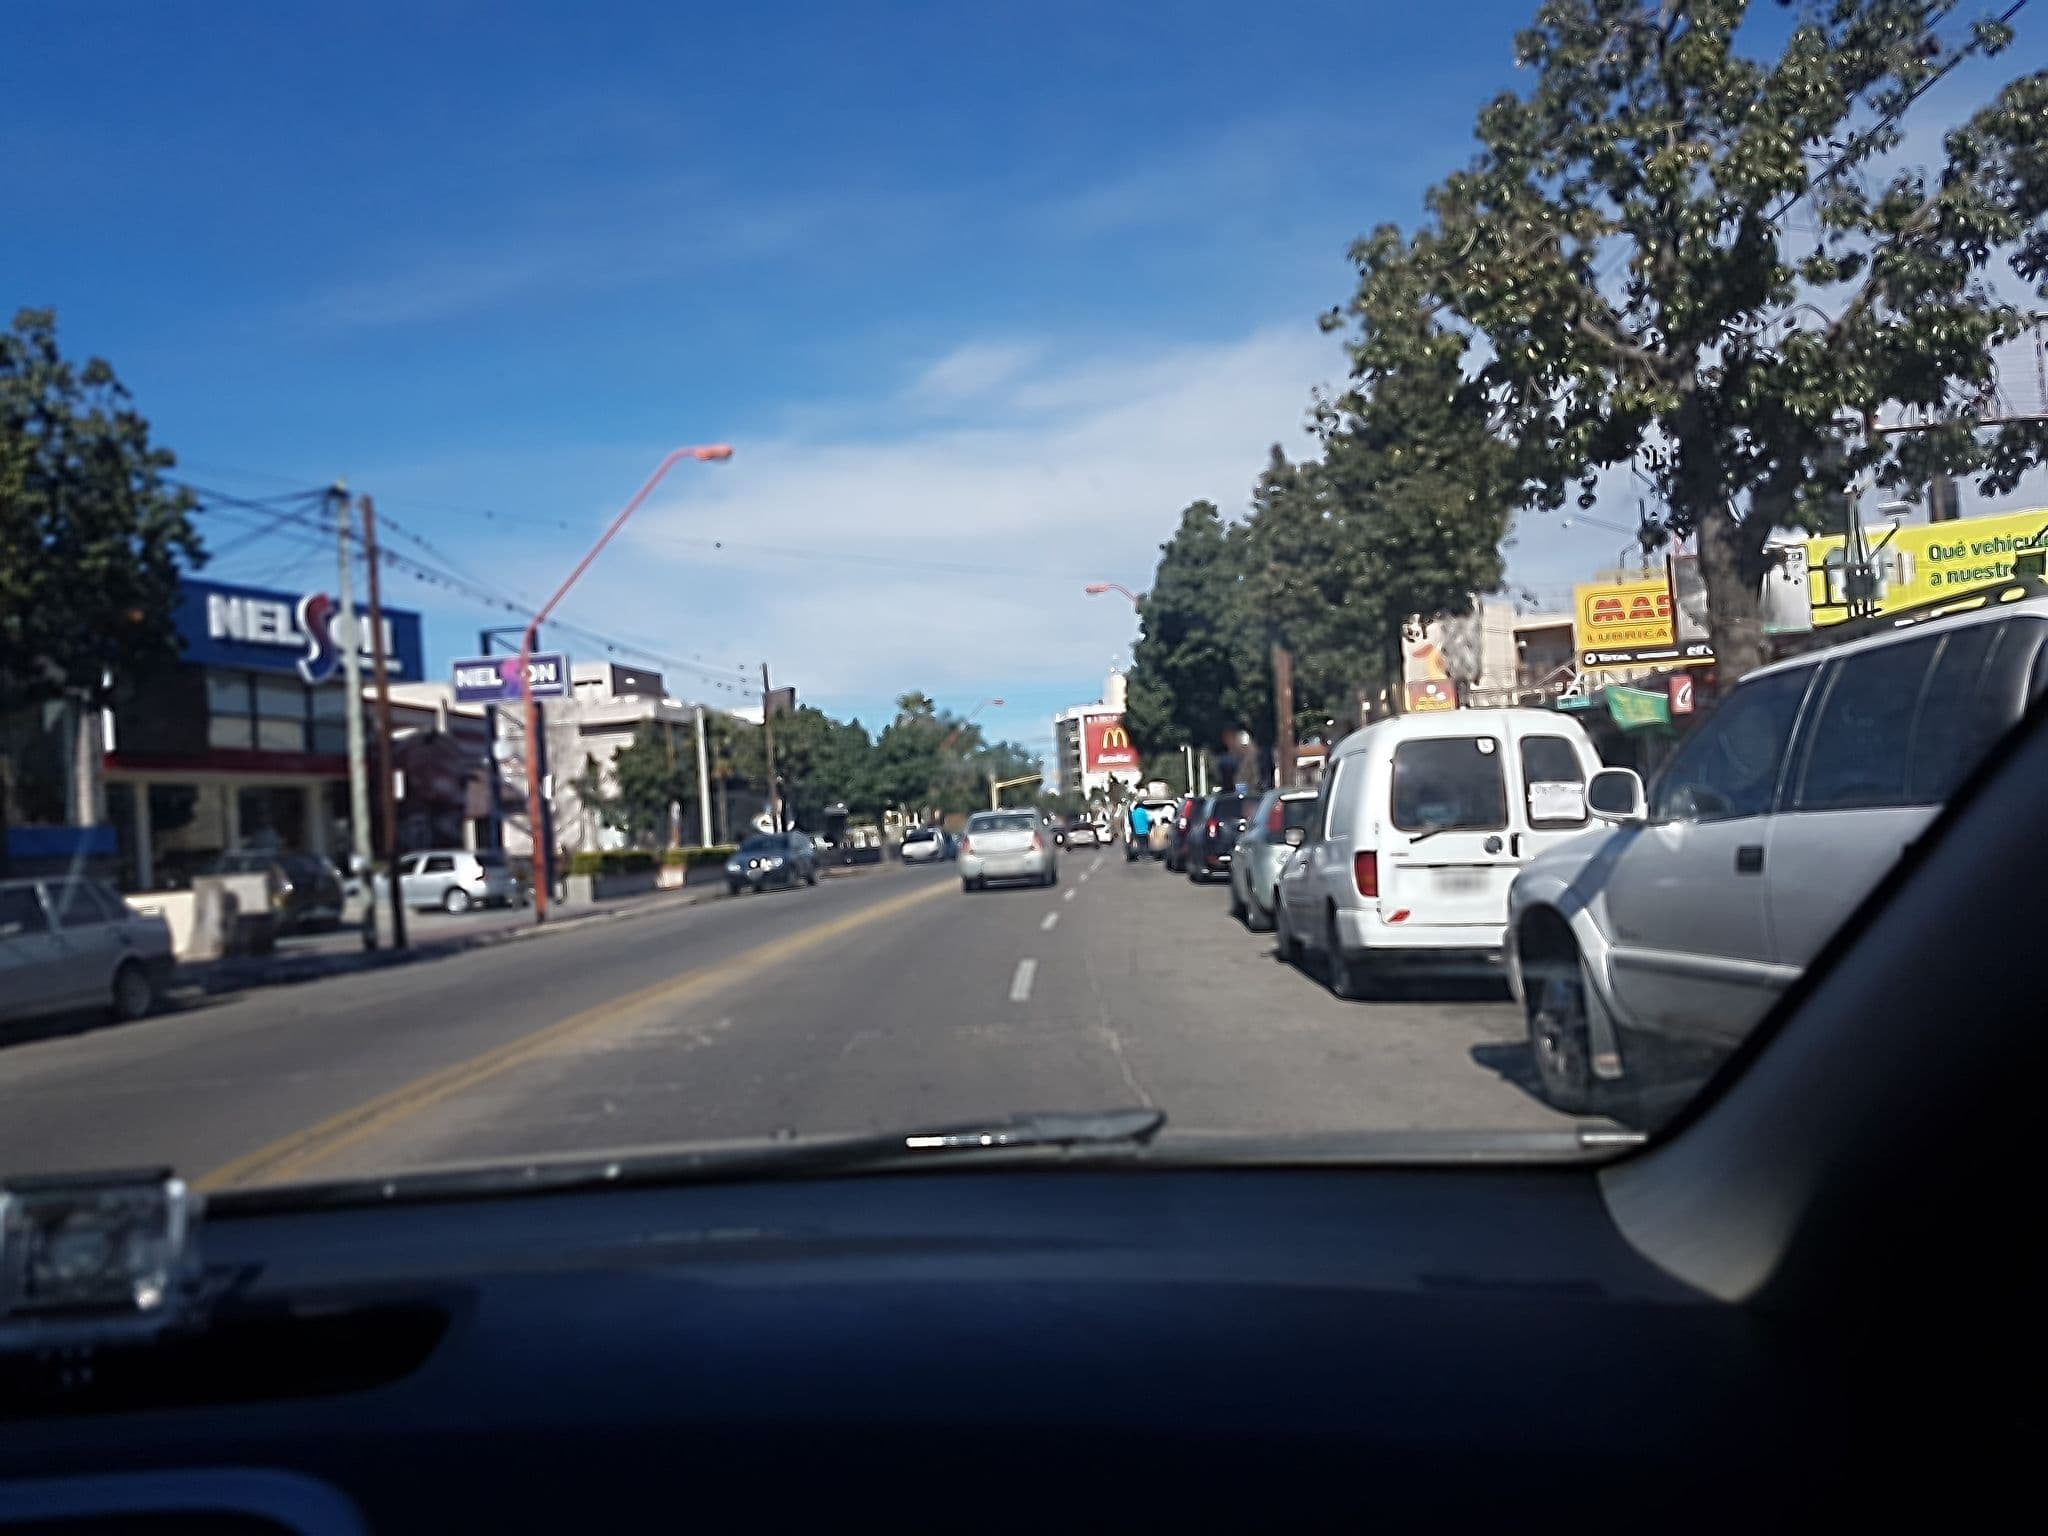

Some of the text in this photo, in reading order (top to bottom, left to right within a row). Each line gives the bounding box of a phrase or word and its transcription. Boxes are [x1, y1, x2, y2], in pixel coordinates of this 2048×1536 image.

[1928, 534, 2048, 561] Qué vehicu
[1931, 561, 2012, 586] a nuestr
